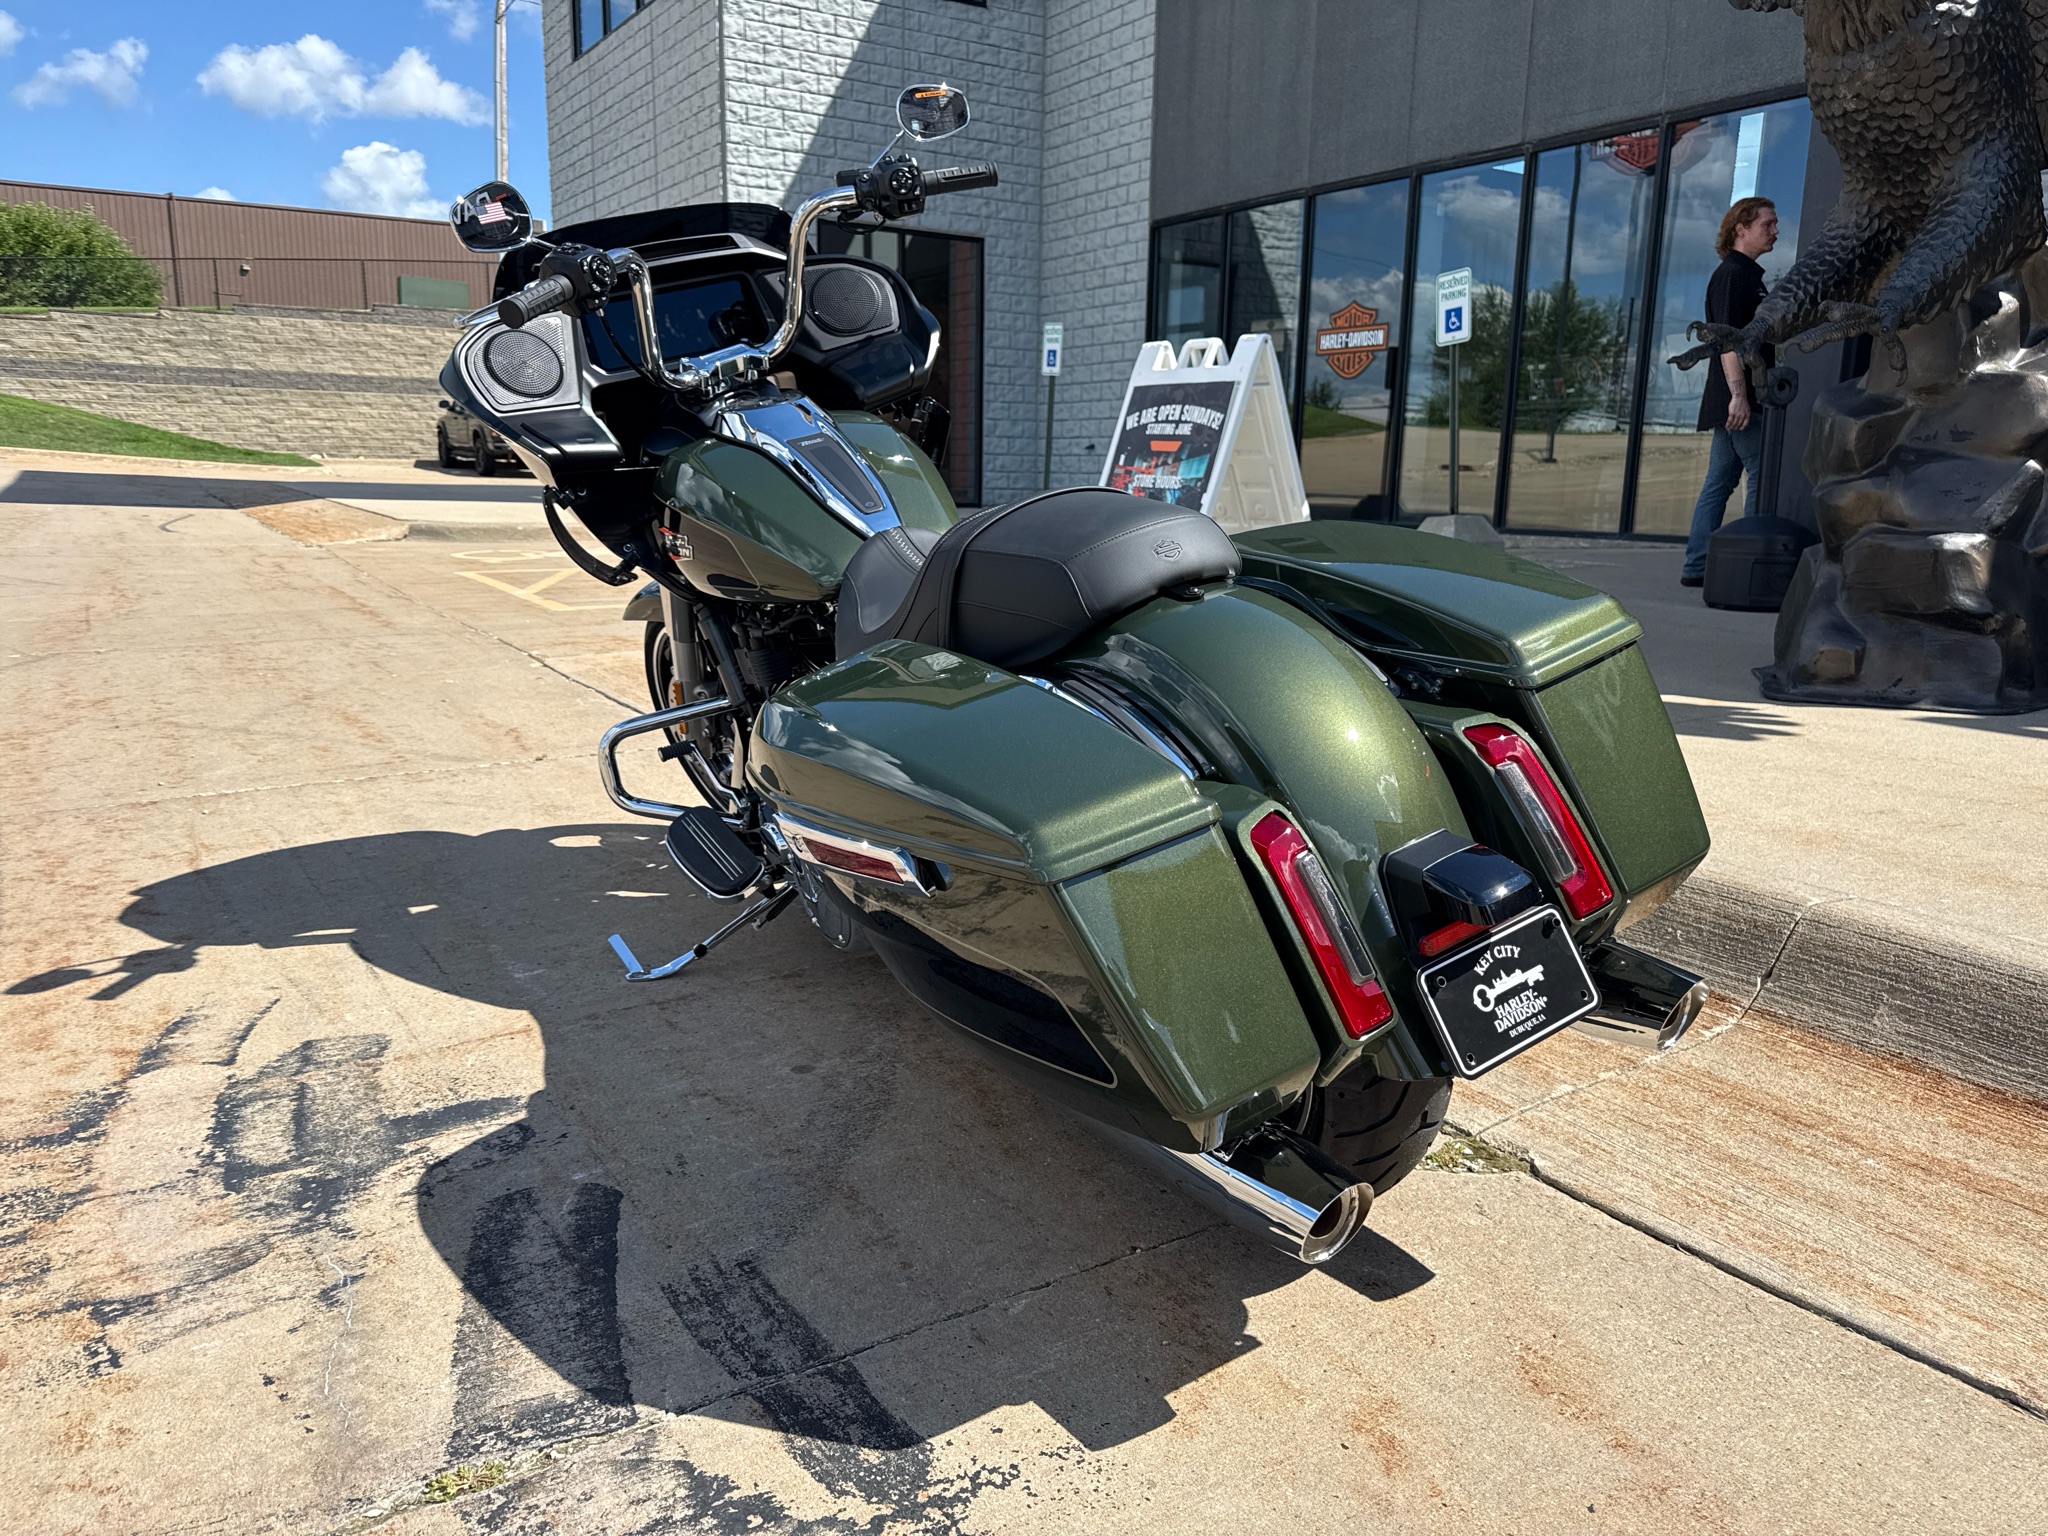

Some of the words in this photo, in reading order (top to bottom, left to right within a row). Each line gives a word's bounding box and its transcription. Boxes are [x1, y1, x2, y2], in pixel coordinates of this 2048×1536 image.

[1440, 276, 1468, 290] RESERVED
[1441, 288, 1467, 301] PARKING
[1336, 310, 1371, 327] MOTOR
[1320, 329, 1384, 350] HARLEY-DAVIDSON
[1333, 352, 1368, 373] CYCLES
[1126, 411, 1140, 431] WE
[1140, 406, 1158, 425] ARE
[1158, 404, 1182, 421] OPEN
[1181, 404, 1225, 430] SUNDAYS!
[1145, 422, 1176, 435] STARTING
[1175, 422, 1193, 435] JUNE
[1133, 474, 1155, 488] STORE
[1473, 950, 1494, 976] KEY
[1493, 945, 1521, 959] CITY
[1494, 988, 1539, 1019] HARLEY-
